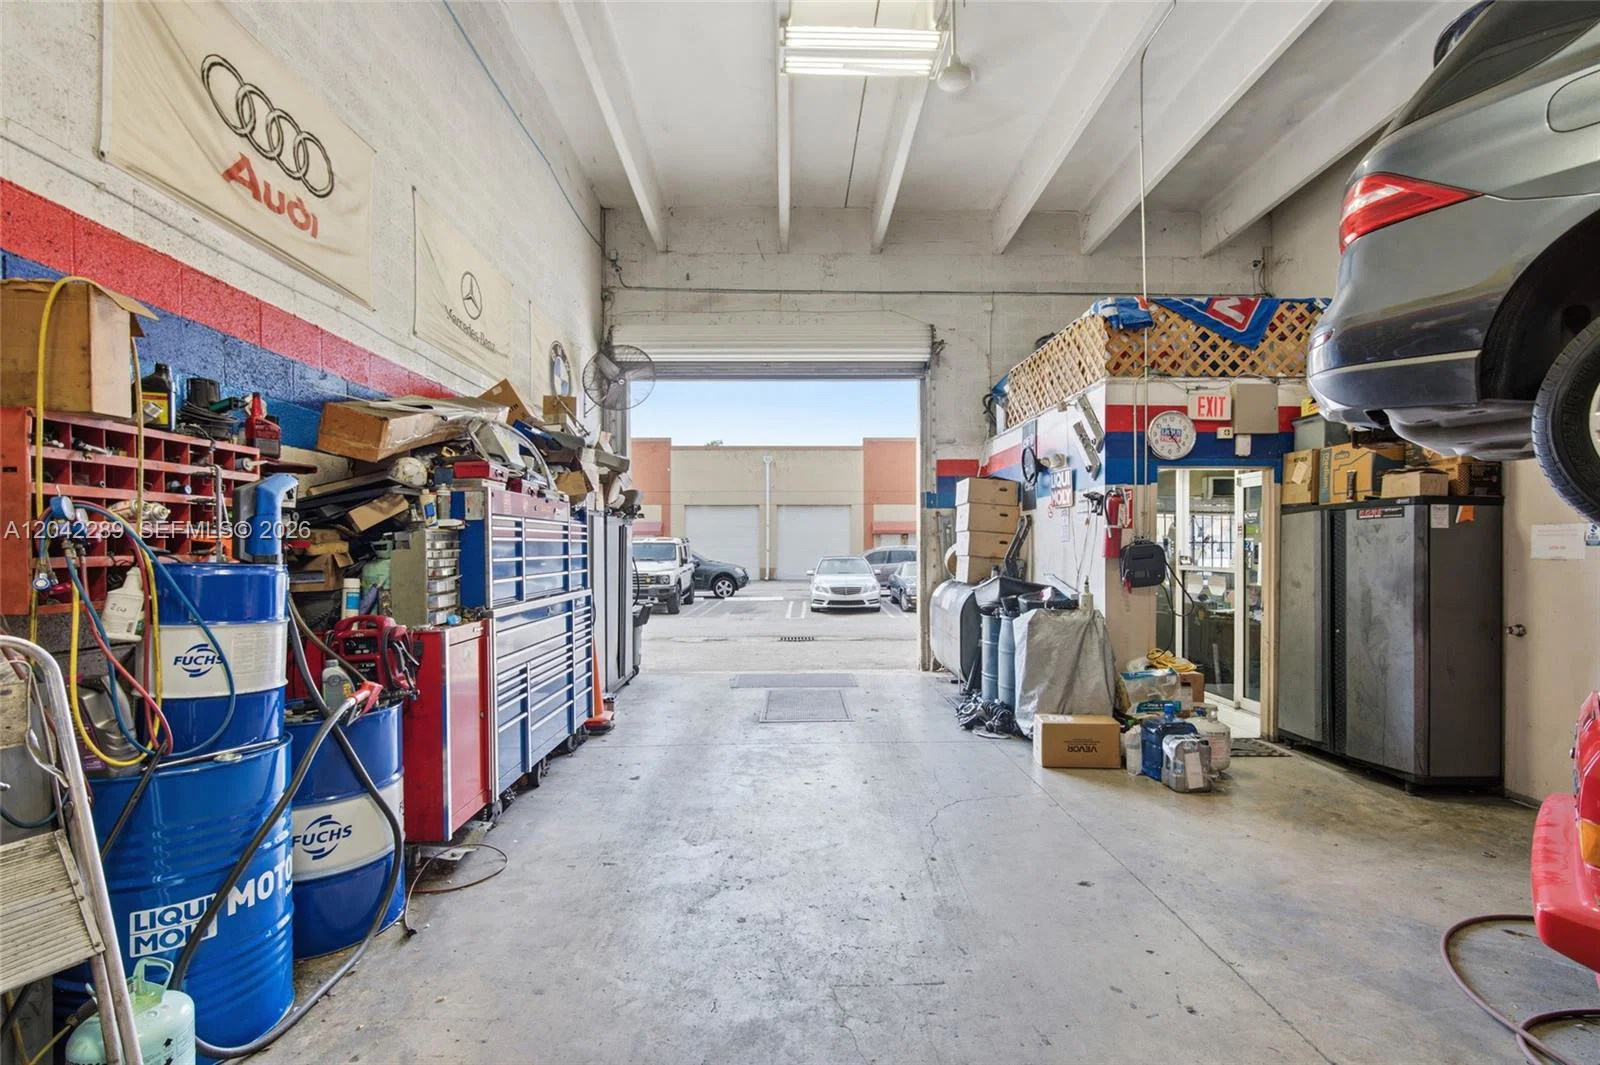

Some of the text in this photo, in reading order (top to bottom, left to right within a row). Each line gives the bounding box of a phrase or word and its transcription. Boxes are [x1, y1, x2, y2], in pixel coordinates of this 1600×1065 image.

[221, 152, 319, 239] Audi
[1197, 396, 1227, 417] EXIT
[1051, 469, 1072, 490] LIQUI
[1051, 489, 1073, 508] MOLY
[173, 655, 224, 666] FUCHS
[1066, 745, 1098, 753] VEVOR
[291, 824, 353, 848] FUCHS
[134, 921, 208, 955] MOL
